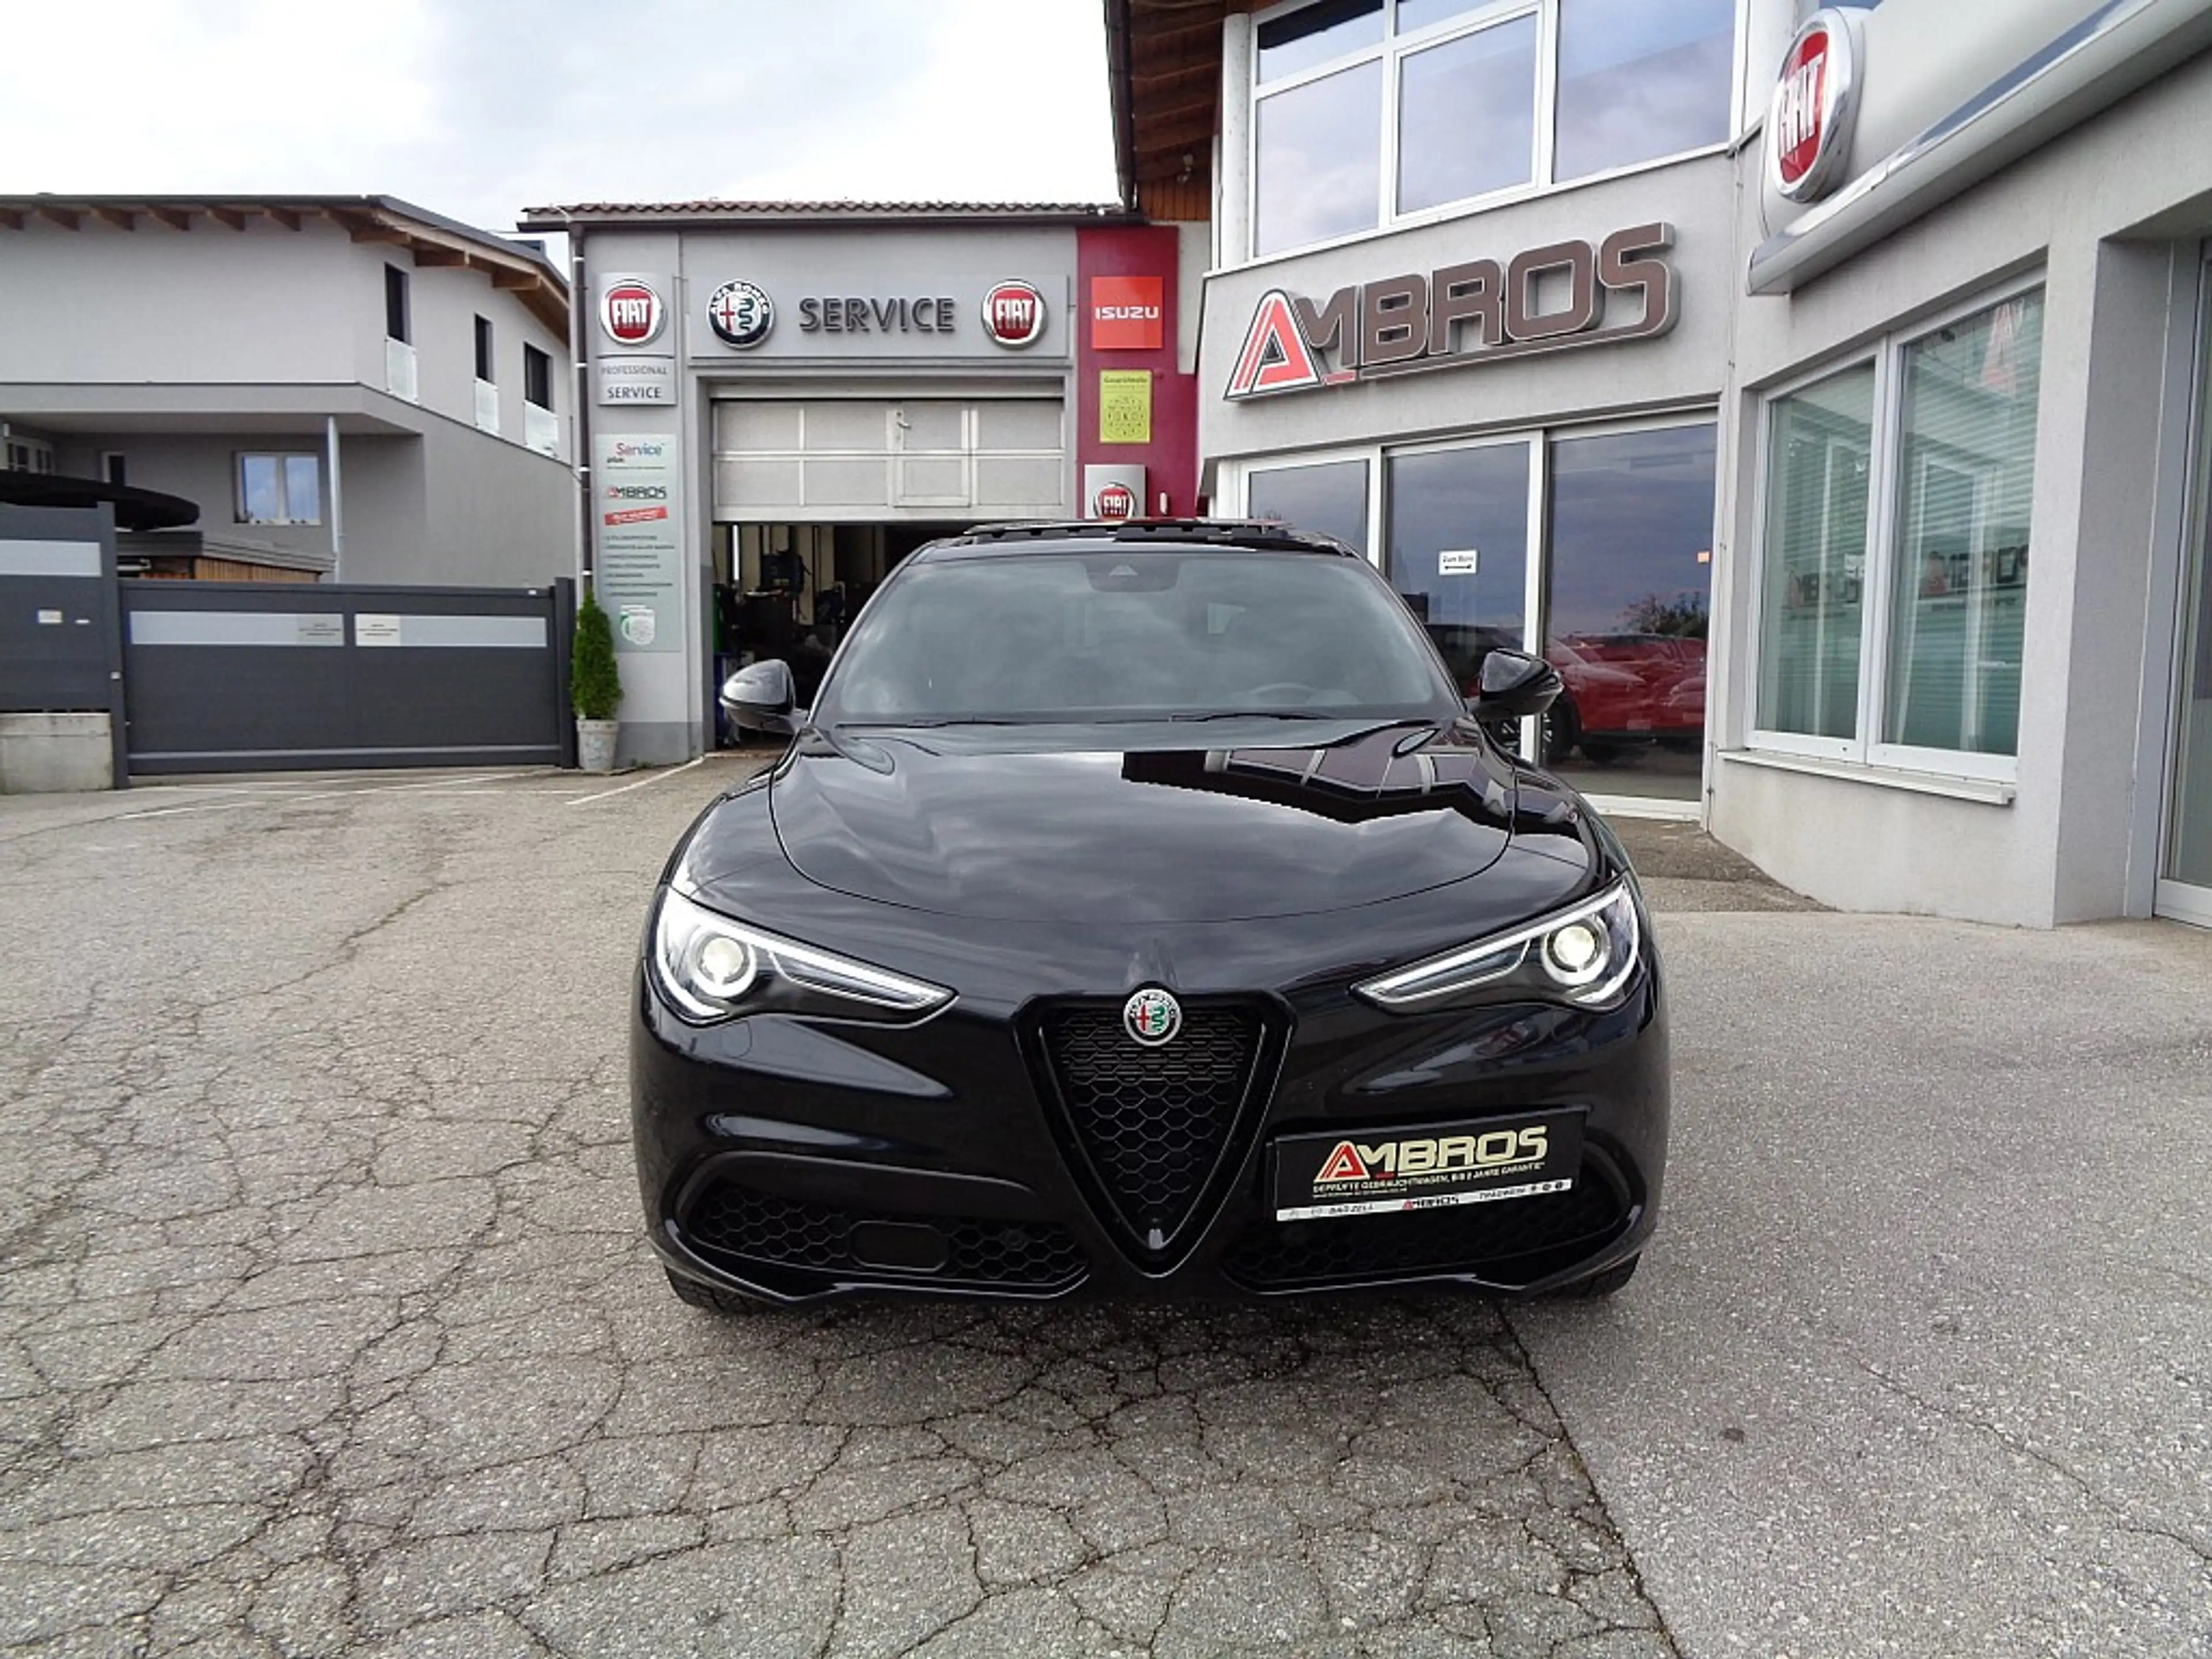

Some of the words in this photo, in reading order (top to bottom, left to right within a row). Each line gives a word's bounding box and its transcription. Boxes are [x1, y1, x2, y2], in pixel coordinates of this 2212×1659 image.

[1778, 52, 1825, 159] FIAT
[611, 298, 649, 329] FIAT
[800, 297, 956, 332] SERVICE
[995, 298, 1033, 329] FIAT
[1096, 306, 1159, 320] ISUZU
[1223, 222, 1680, 403] AMBROS
[601, 365, 667, 375] PROFESSIONAL
[607, 387, 661, 399] SERVICE
[605, 485, 667, 500] AMBROS
[1103, 495, 1127, 515] FIAT
[1314, 1125, 1547, 1183] AMBROS
